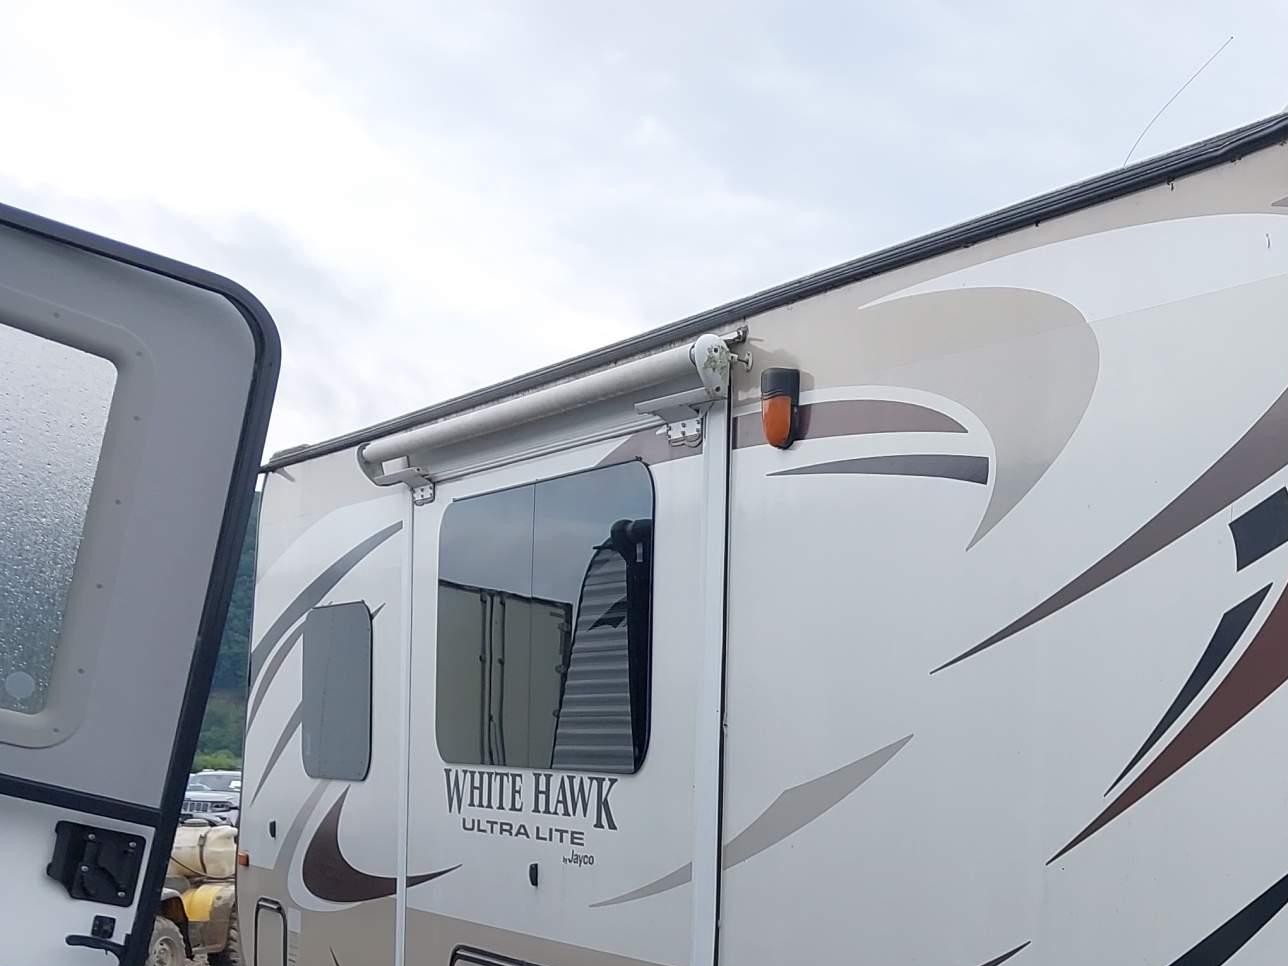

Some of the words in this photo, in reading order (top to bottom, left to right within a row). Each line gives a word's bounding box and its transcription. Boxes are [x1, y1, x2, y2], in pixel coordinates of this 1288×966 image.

[444, 768, 524, 814] WHITE
[531, 772, 618, 830] HAWK
[462, 817, 530, 839] ULTRA
[535, 826, 585, 846] LITE
[568, 849, 595, 868] Jayco
